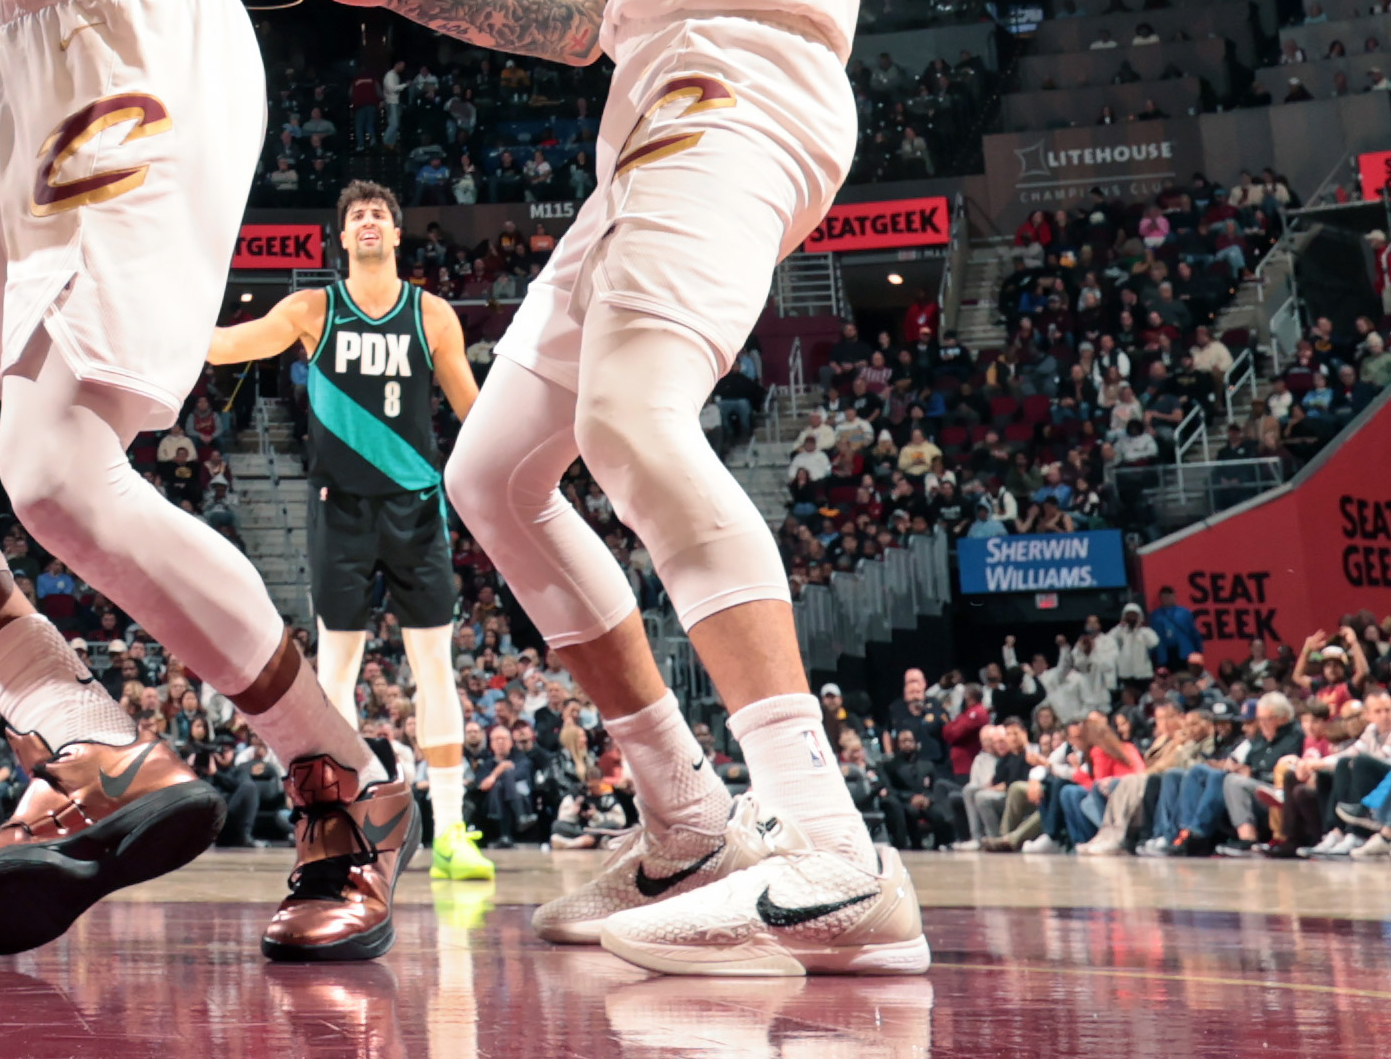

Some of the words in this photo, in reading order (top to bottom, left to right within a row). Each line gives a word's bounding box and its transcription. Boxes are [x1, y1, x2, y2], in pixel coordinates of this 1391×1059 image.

[1047, 141, 1173, 168] LITEHOUSE
[1020, 183, 1122, 204] CHAMPINS
[530, 202, 575, 219] M115
[334, 331, 412, 377] PDX
[383, 380, 401, 418] 8
[985, 537, 1089, 564] SHERWIN
[1188, 570, 1271, 605] SEAT
[1192, 607, 1282, 643] GEEK
